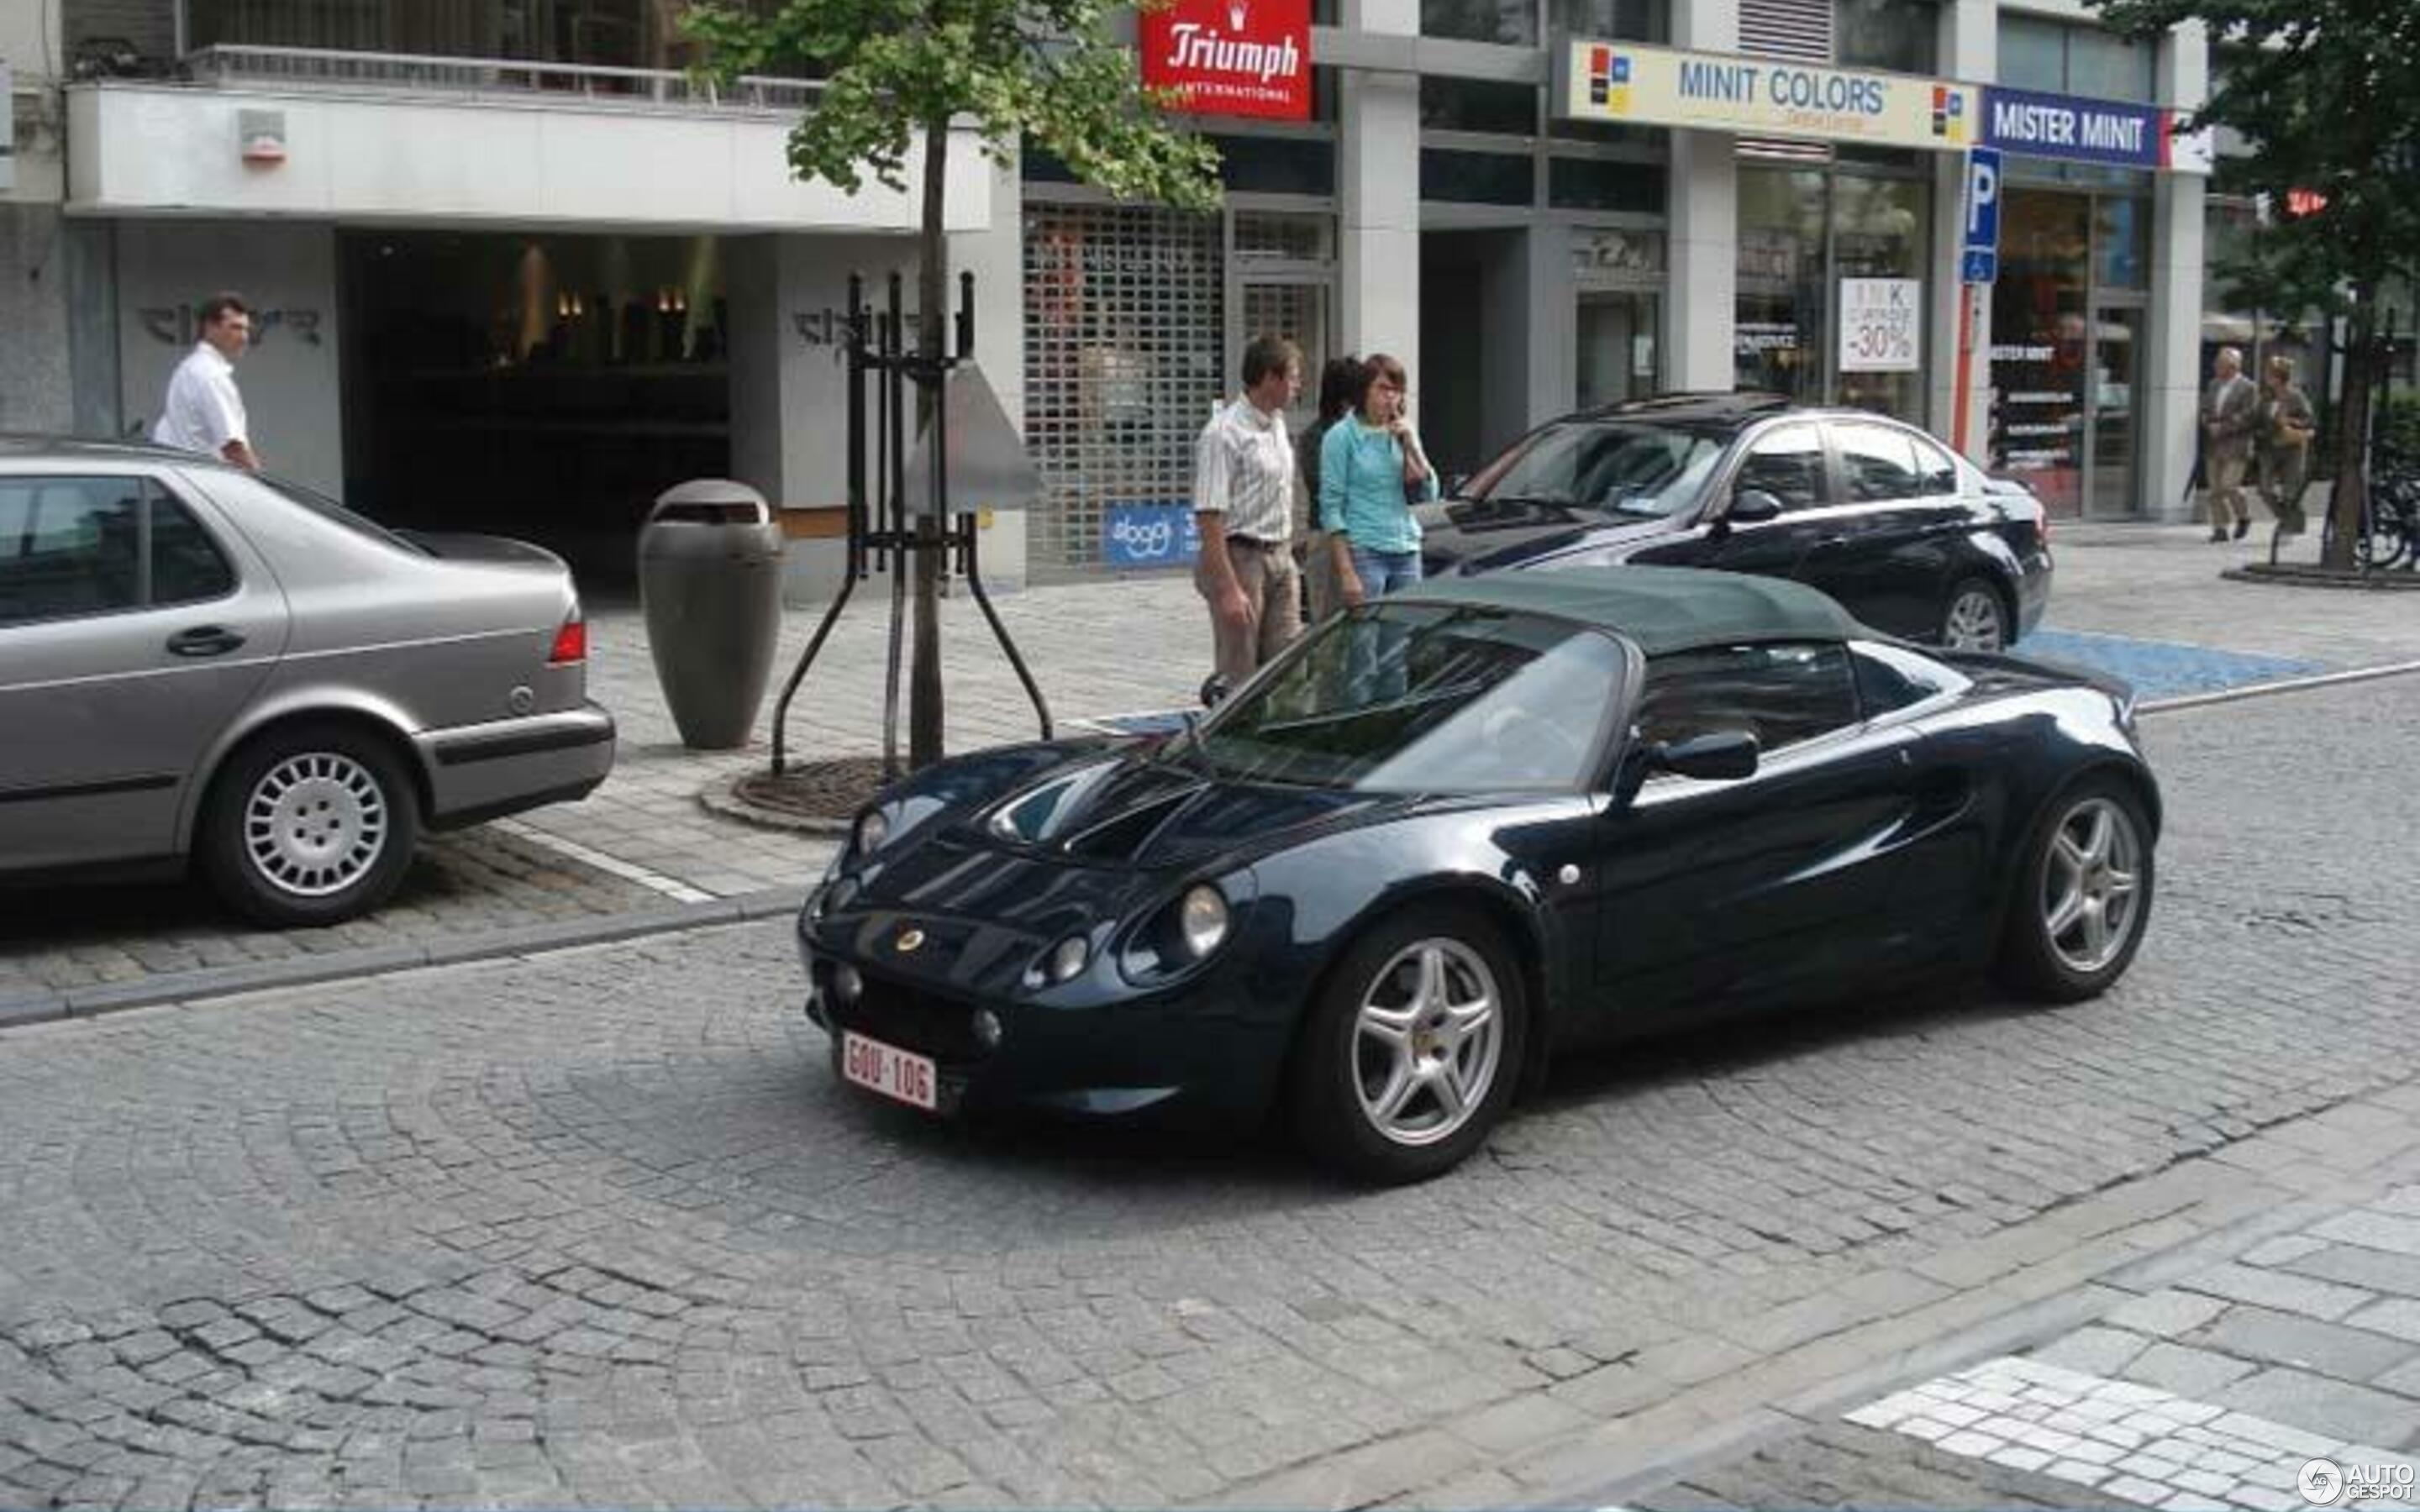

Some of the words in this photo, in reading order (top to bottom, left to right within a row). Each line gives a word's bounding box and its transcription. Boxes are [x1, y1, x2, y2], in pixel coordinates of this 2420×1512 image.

[1168, 23, 1298, 83] Triumph
[1174, 81, 1291, 104] INTERNATIONAL
[1679, 60, 1758, 103] MINIT
[1769, 69, 1883, 114] COLORS
[1994, 102, 2077, 145] MISTER
[2081, 112, 2145, 152] MINIT
[1969, 163, 1996, 234] P
